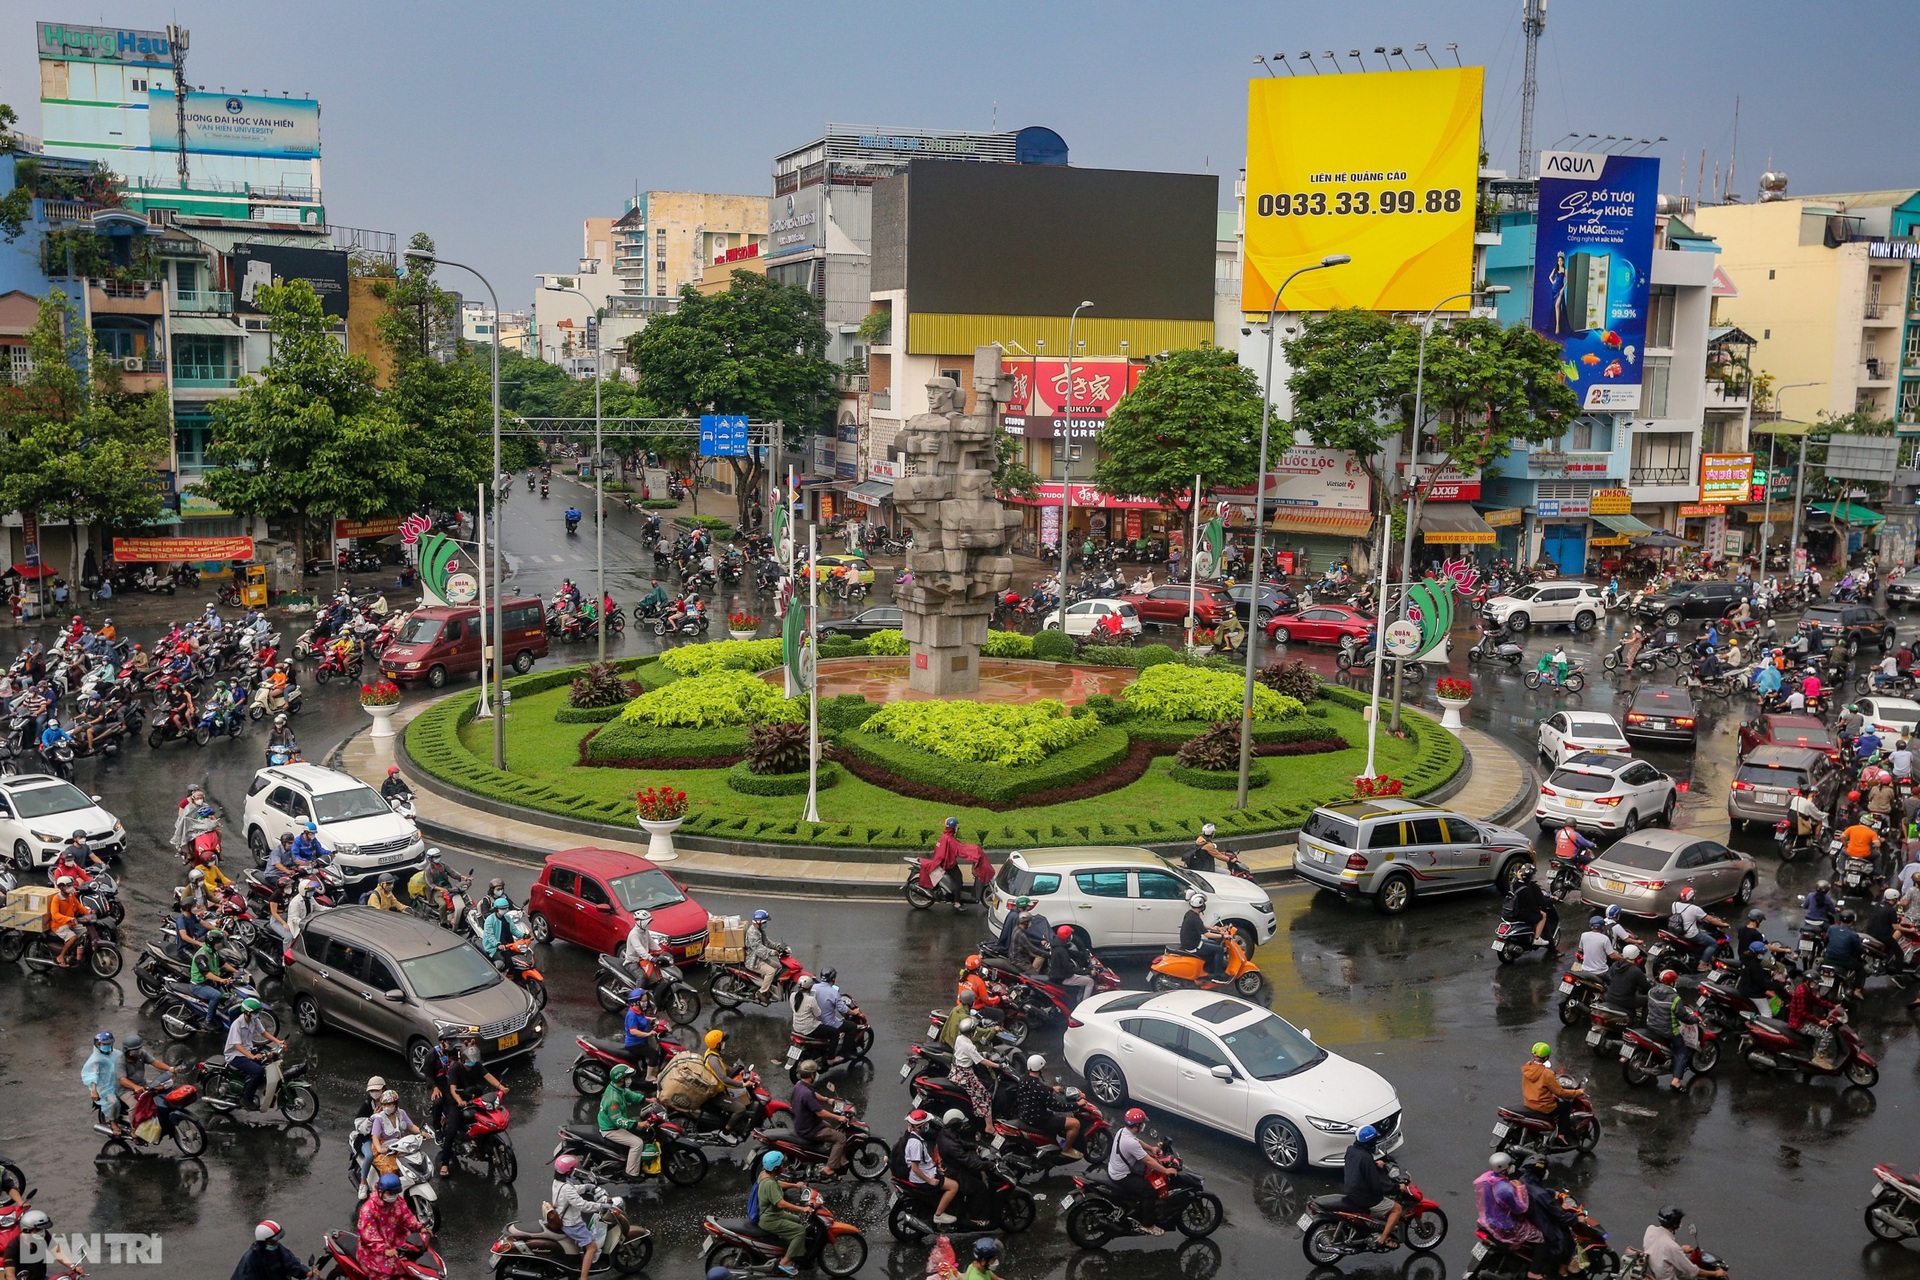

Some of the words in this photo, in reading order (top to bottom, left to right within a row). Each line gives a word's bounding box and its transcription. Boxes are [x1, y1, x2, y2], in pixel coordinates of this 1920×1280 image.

[44, 25, 168, 57] HungHau
[234, 126, 274, 135] UNIVERSITY
[1547, 156, 1594, 173] AQUA
[1310, 172, 1332, 183] LIÊN
[1335, 172, 1346, 184] HỆ
[1350, 170, 1384, 183] QUẢNG
[1386, 170, 1407, 181] CÁO
[1258, 189, 1461, 216] 0933.33.99.88
[1592, 189, 1608, 201] ĐỒ
[1610, 191, 1635, 203] TƯƠI
[1557, 191, 1604, 224] Sống
[1605, 203, 1634, 216] KHỎE
[1568, 224, 1577, 235] by
[1567, 235, 1581, 243] Công
[1869, 242, 1891, 258] MINH
[1893, 242, 1905, 258] HY
[1611, 308, 1637, 318] 99.9%
[1311, 455, 1335, 470] LỘC
